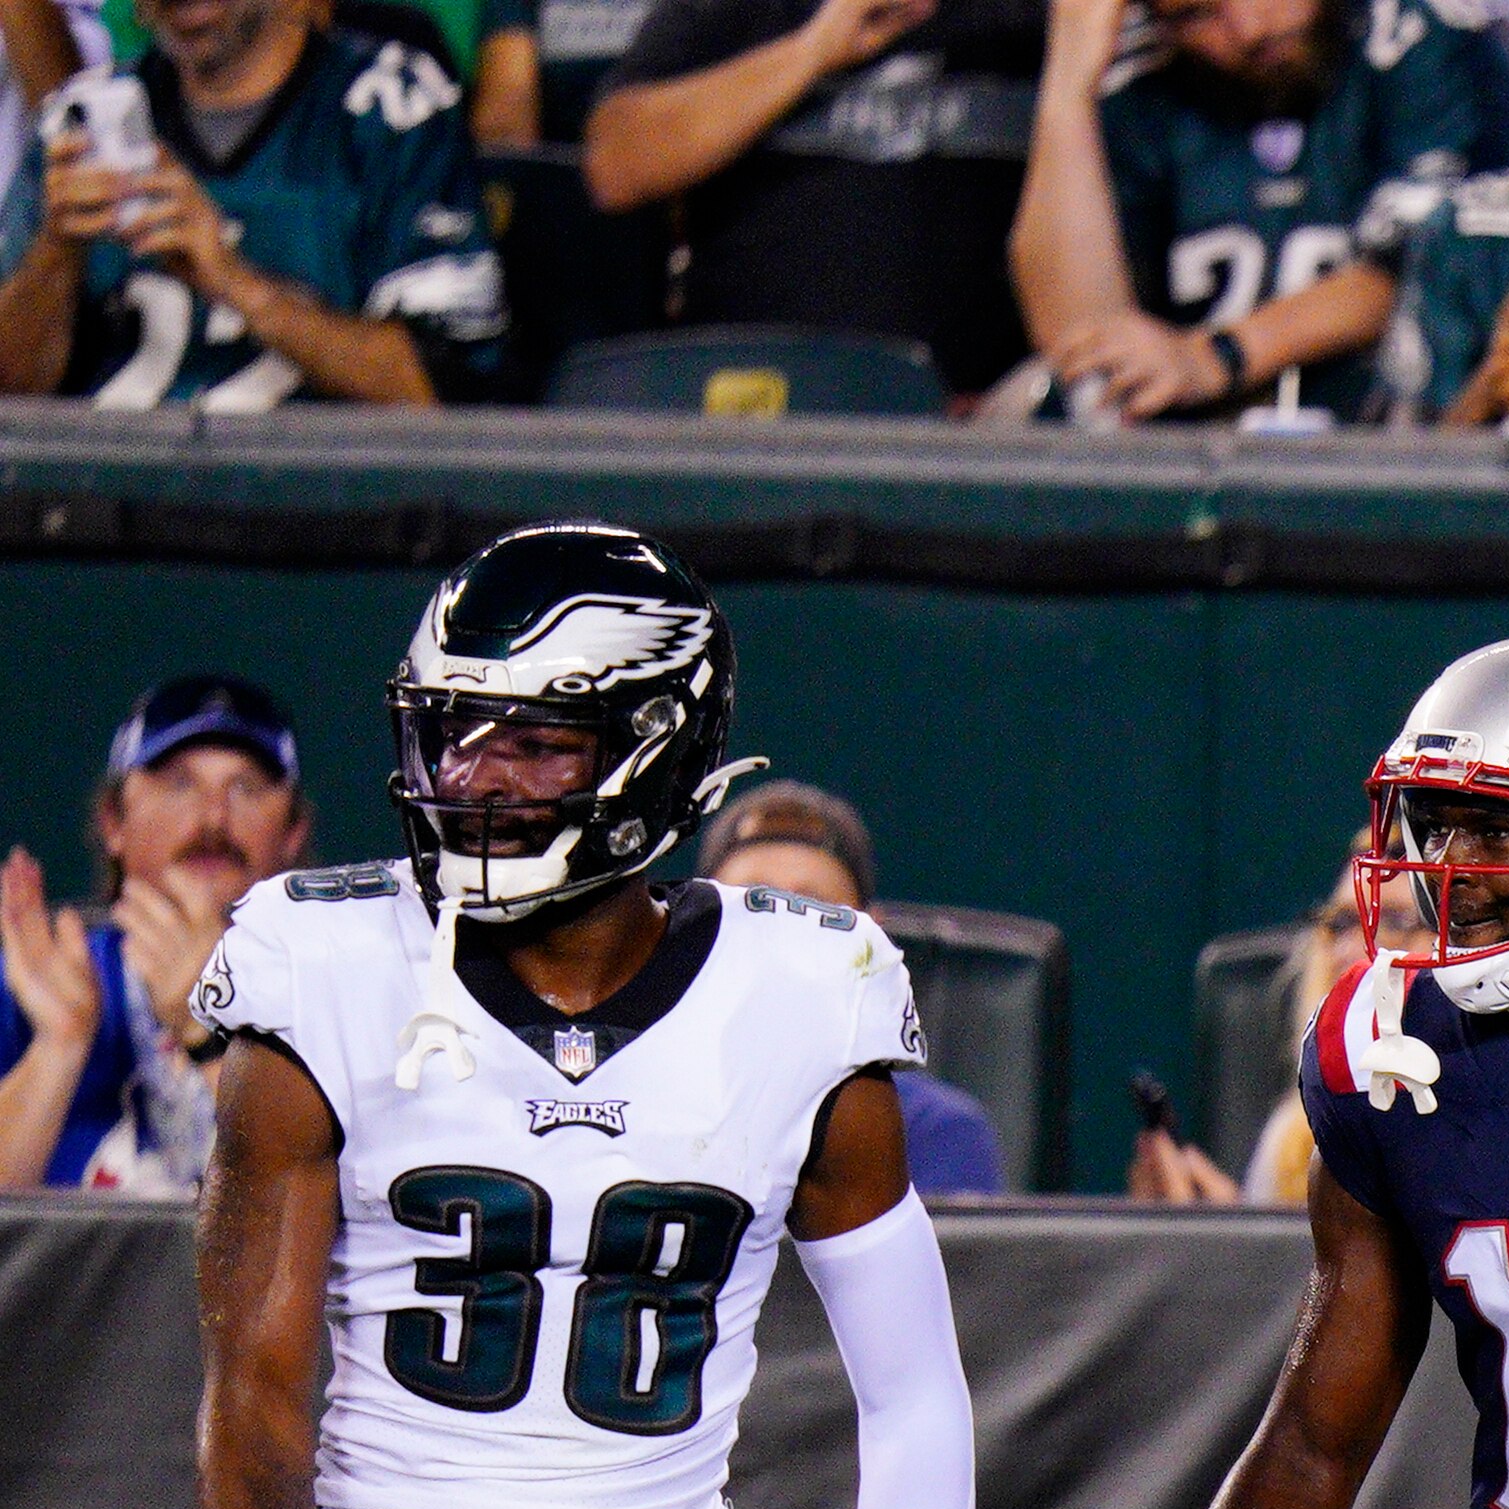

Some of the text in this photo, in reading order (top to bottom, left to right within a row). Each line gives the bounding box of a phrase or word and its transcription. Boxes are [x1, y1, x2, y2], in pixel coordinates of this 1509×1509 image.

[561, 1047, 590, 1064] NFL
[524, 1099, 631, 1138] EAGLES
[385, 1165, 755, 1436] 38
